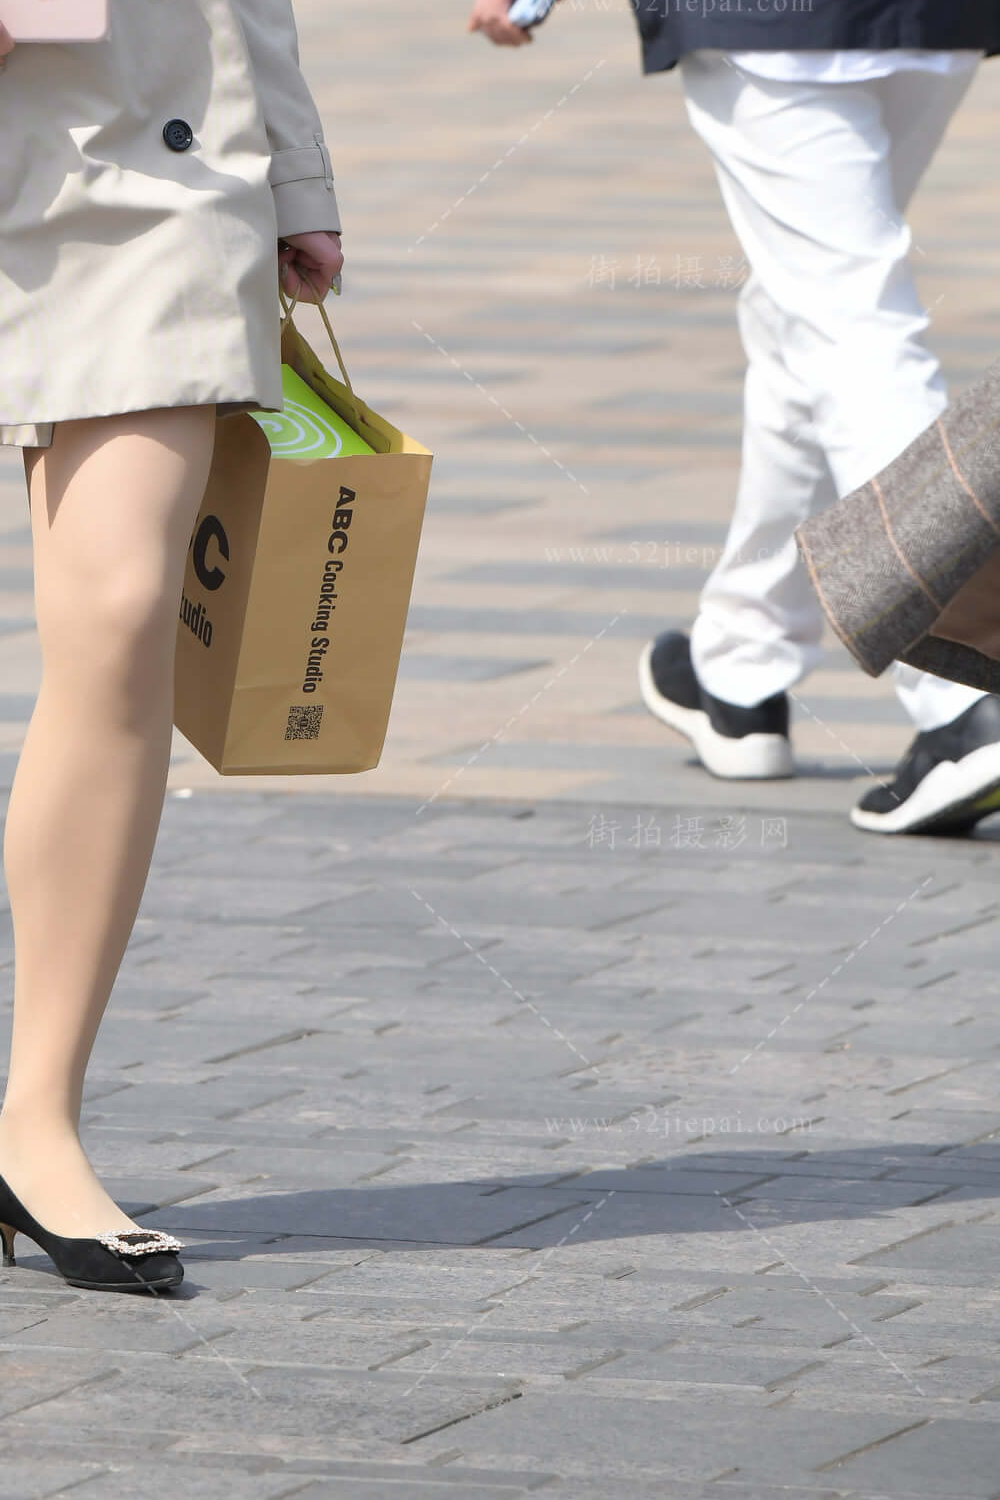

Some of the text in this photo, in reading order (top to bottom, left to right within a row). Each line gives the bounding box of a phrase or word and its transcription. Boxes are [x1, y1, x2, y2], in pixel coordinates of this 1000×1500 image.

[302, 485, 356, 693] ABC Cooking Studio
